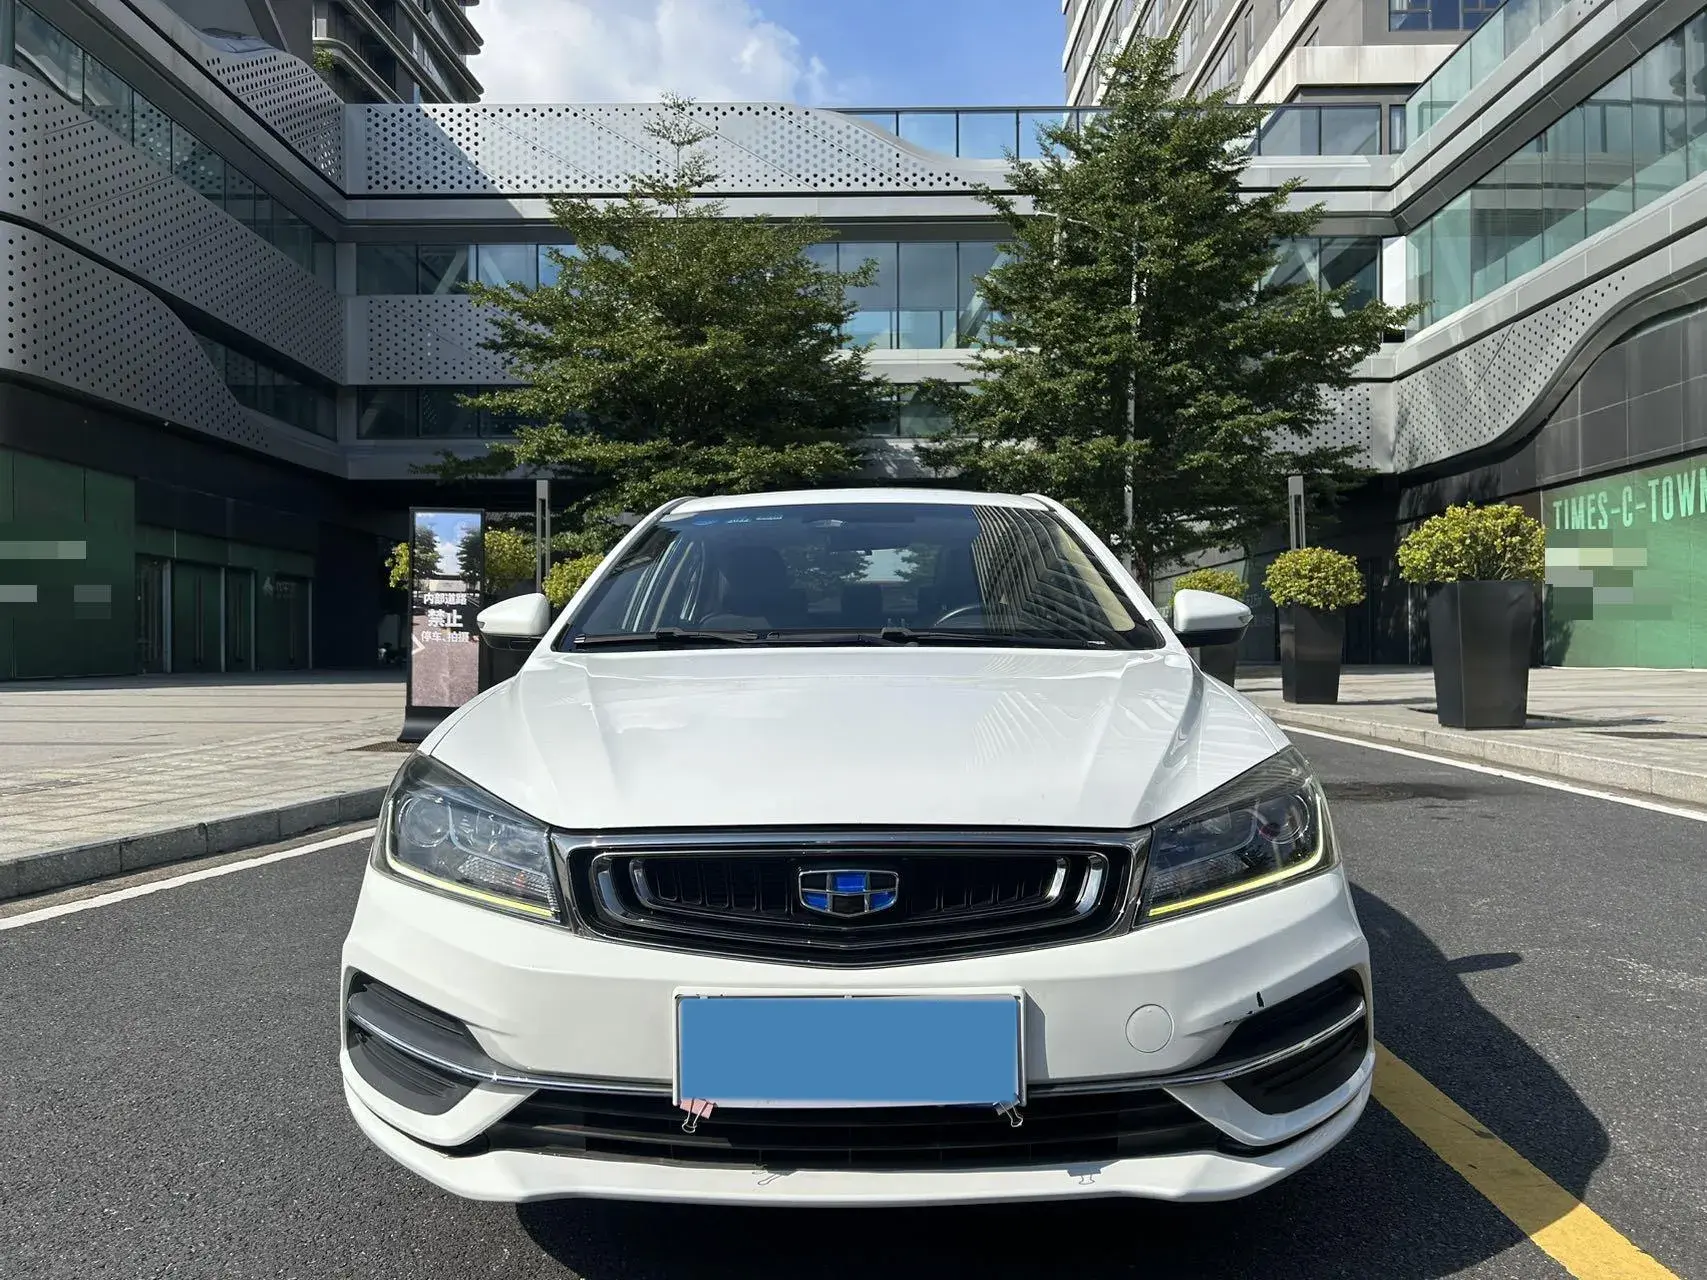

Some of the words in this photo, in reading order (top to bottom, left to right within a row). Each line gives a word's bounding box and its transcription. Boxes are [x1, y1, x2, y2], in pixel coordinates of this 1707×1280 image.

[423, 592, 467, 605] 内部道路
[427, 608, 463, 628] 禁止
